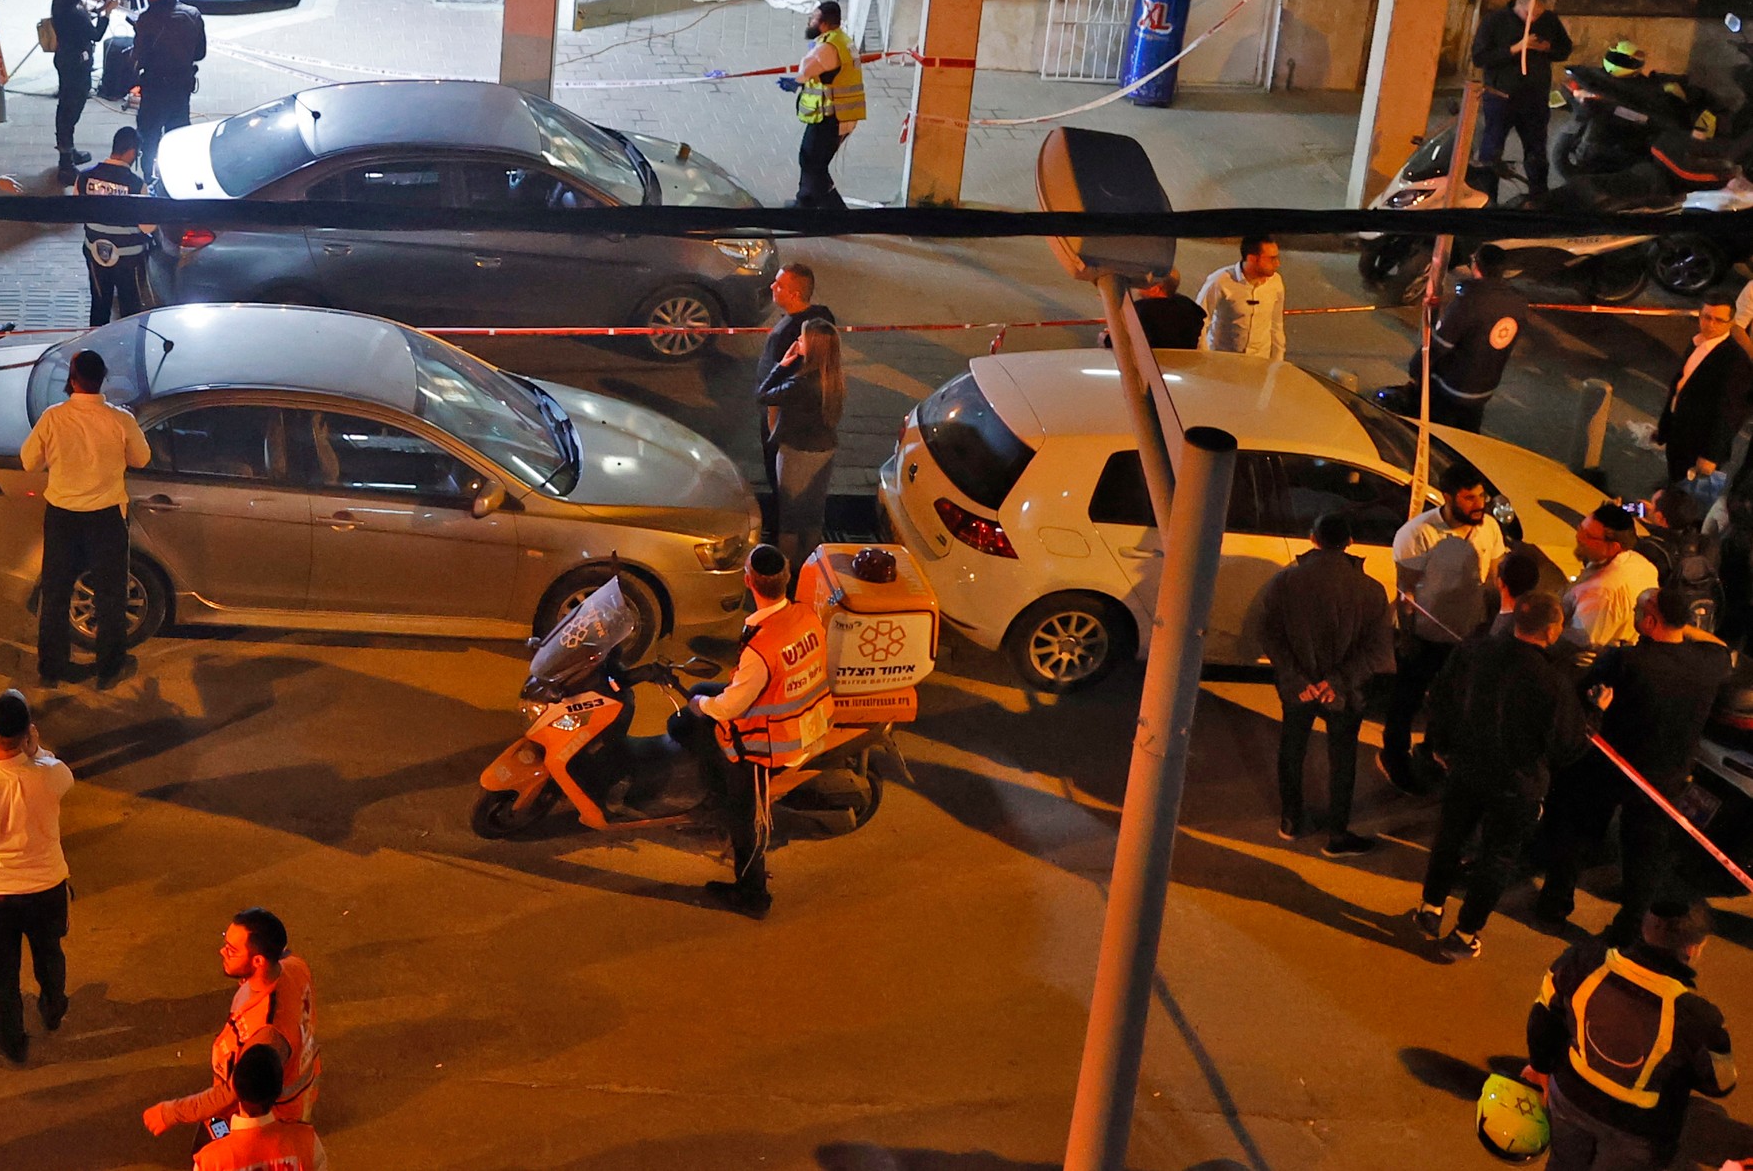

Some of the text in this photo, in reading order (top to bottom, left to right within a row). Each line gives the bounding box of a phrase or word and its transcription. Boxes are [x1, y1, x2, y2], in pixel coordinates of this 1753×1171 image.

[781, 632, 819, 666] חובש
[836, 664, 916, 677] איחוד הצלה
[565, 698, 605, 713] 1053
